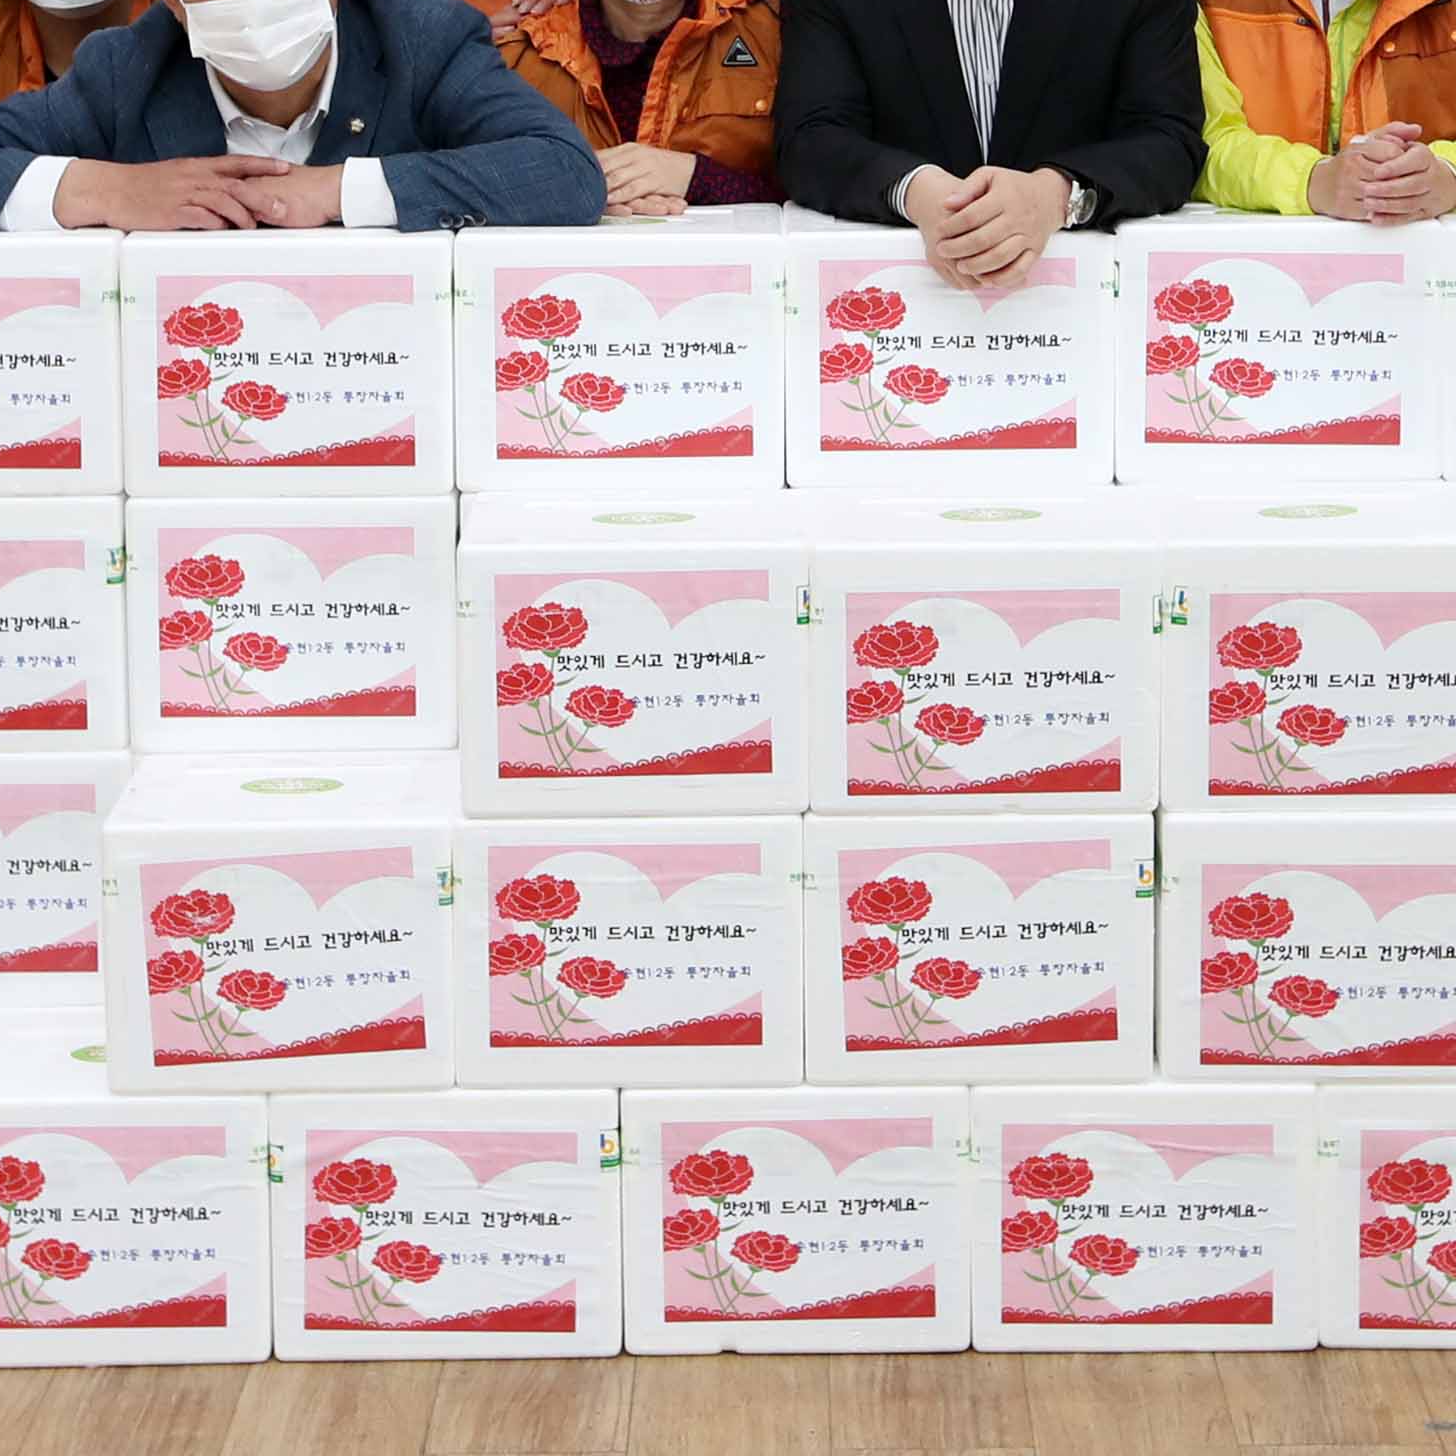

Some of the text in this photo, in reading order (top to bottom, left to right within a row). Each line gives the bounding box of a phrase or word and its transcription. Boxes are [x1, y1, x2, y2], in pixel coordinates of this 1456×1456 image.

[553, 653, 604, 670] 맛있게
[615, 653, 664, 668] 드시고
[903, 671, 955, 689] 맛있게
[964, 671, 1014, 687] 드시고
[1269, 673, 1317, 690] 맛있게
[1327, 673, 1376, 688] 드시고
[546, 925, 596, 942] 맛있게
[607, 925, 655, 940] 드시고
[898, 926, 949, 944] 맛있게
[959, 924, 1008, 940] 드시고
[202, 937, 253, 955] 맛있게
[263, 935, 313, 951] 드시고
[1259, 944, 1309, 961] 맛있게
[1319, 945, 1368, 960] 드시고
[13, 1206, 61, 1223] 맛있게
[71, 1207, 120, 1222] 드시고
[721, 1199, 770, 1216] 맛있게
[780, 1199, 828, 1214] 드시고
[1058, 1204, 1109, 1221] 맛있게
[1119, 1204, 1167, 1219] 드시고
[364, 1210, 412, 1226] 맛있게
[422, 1211, 471, 1225] 드시고
